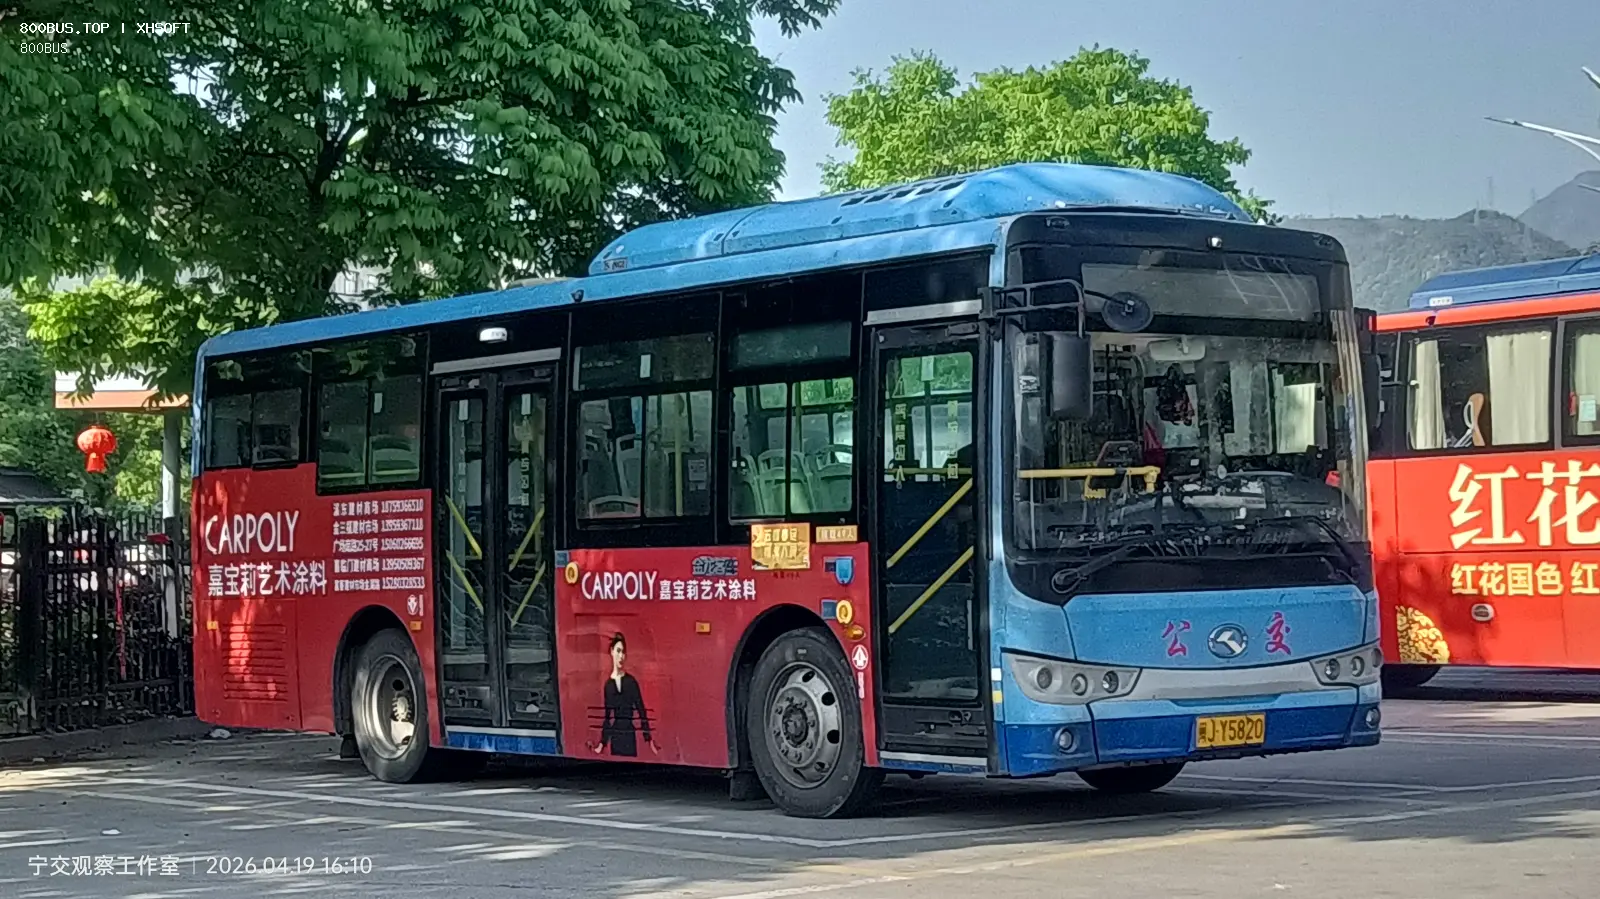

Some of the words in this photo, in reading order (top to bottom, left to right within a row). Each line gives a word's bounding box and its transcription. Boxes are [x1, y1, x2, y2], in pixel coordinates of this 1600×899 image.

[1448, 460, 1600, 550] 红花
[204, 510, 300, 555] CARPOLY
[207, 560, 328, 597] 嘉宝莉艺术涂料
[581, 571, 658, 600] CARPOLY
[659, 578, 757, 601] 嘉宝莉艺术涂料
[1451, 561, 1564, 596] 红花国色
